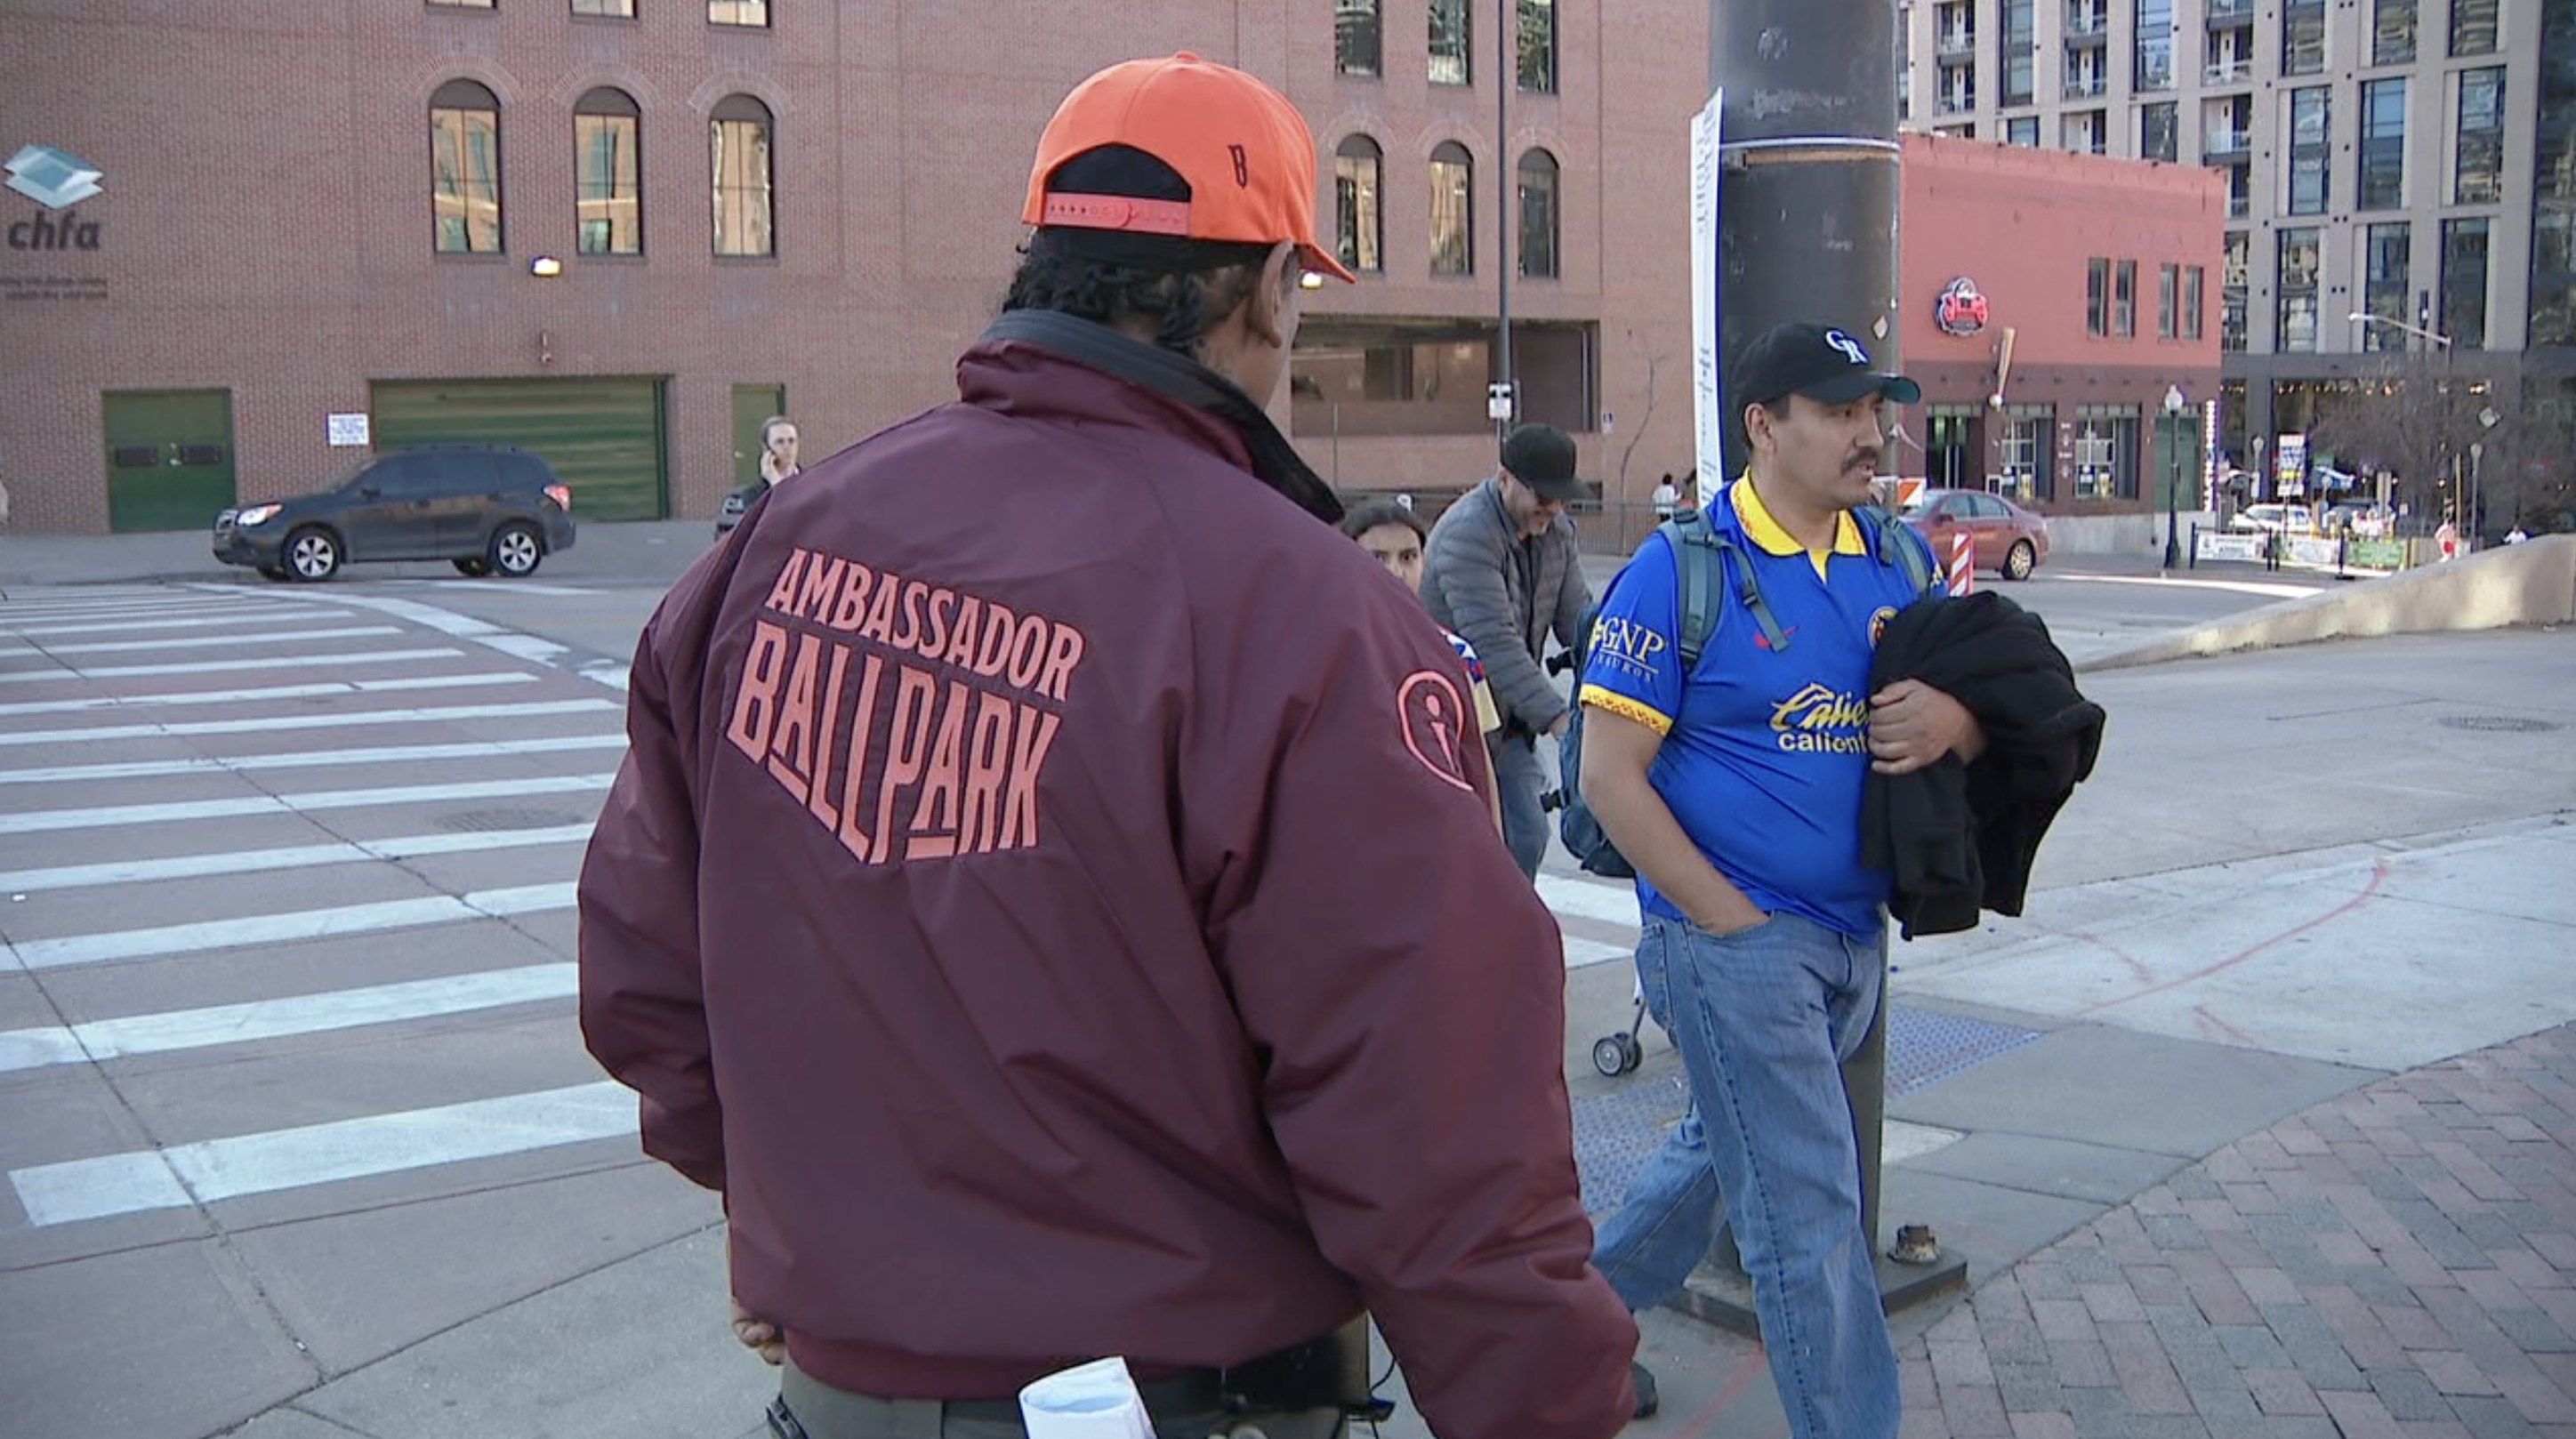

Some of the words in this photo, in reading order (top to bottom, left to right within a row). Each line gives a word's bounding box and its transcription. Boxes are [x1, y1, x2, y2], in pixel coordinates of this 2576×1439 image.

[8, 210, 101, 250] chfa
[1825, 330, 1869, 364] CR
[765, 547, 1084, 703] AMBASSADOR
[1602, 615, 1663, 663] GNP
[1769, 681, 1870, 729] Calie
[726, 620, 1061, 864] BALLPARK
[1778, 731, 1868, 754] calient
